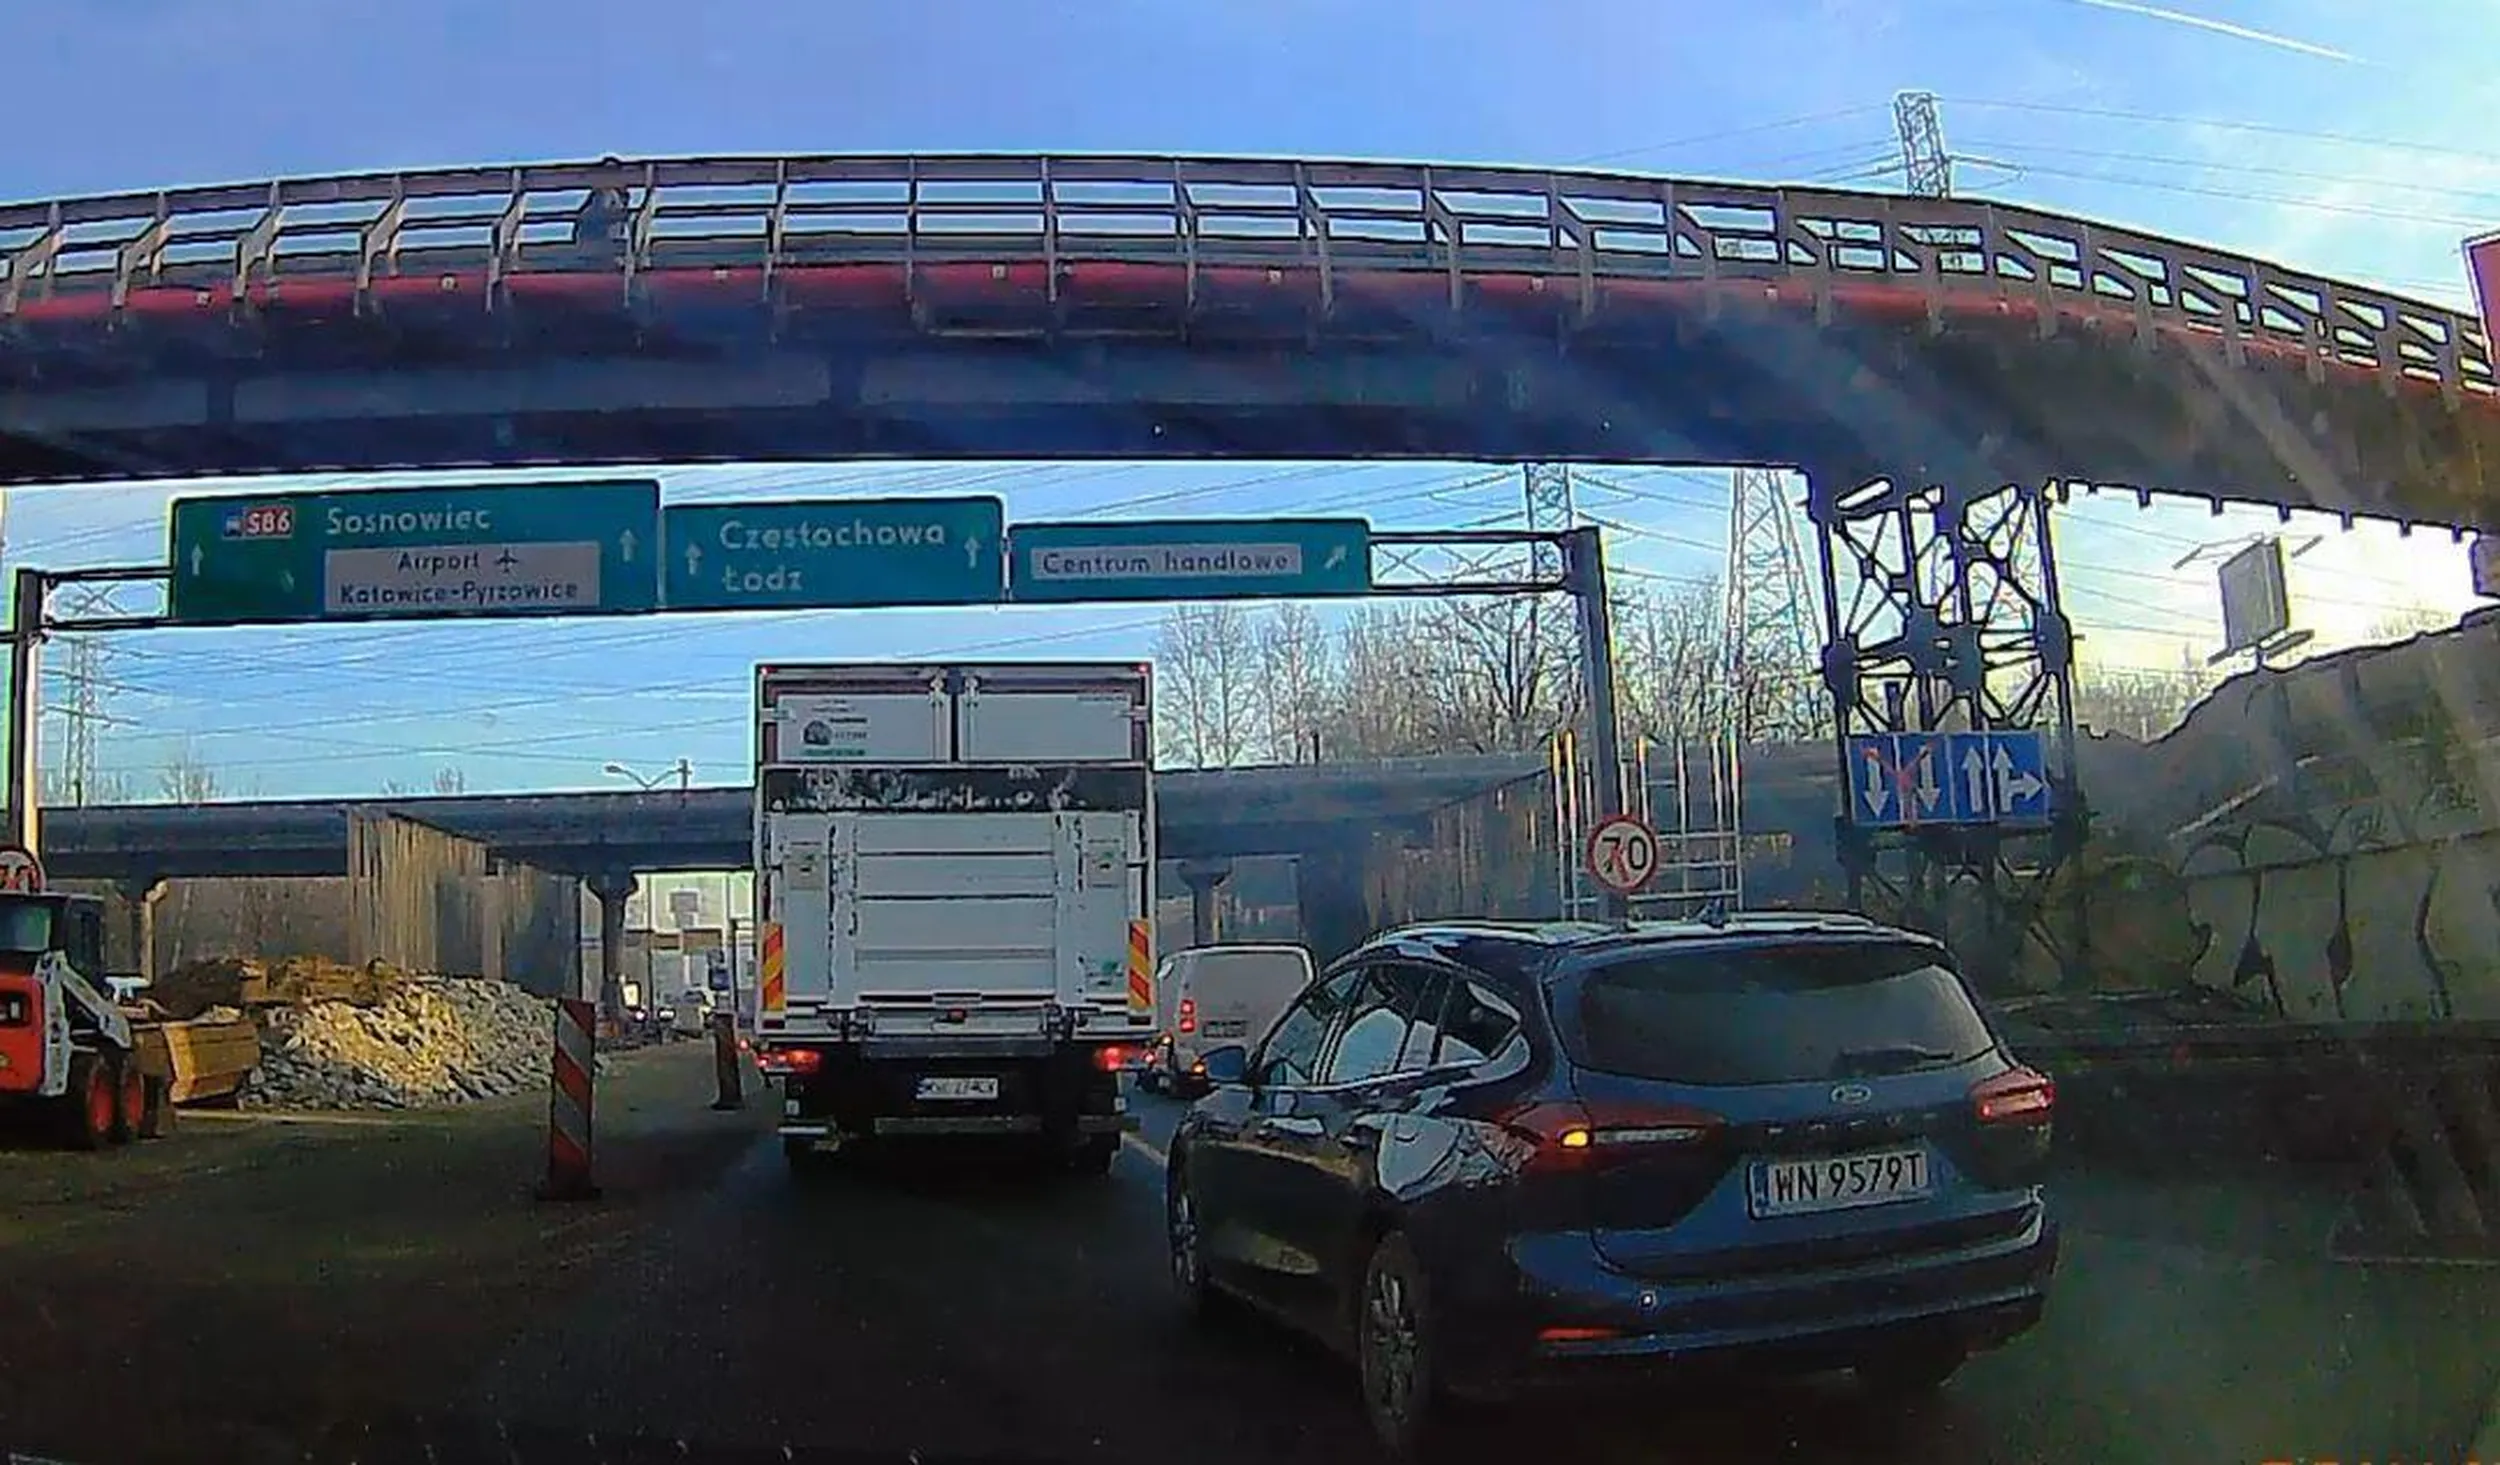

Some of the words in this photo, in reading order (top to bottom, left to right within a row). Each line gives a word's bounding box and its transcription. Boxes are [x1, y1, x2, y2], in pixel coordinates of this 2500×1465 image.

[246, 511, 291, 534] S86
[325, 504, 492, 535] Sosnowiec
[719, 518, 945, 553] Częstochowa
[397, 552, 480, 576] Airport
[1042, 552, 1150, 575] Centrum
[1164, 550, 1289, 572] handlowe
[340, 580, 579, 604] Katowice-Pyrzowice
[1601, 834, 1648, 873] 70
[1775, 1163, 1818, 1202] WN
[1828, 1153, 1922, 1198] 9579T
